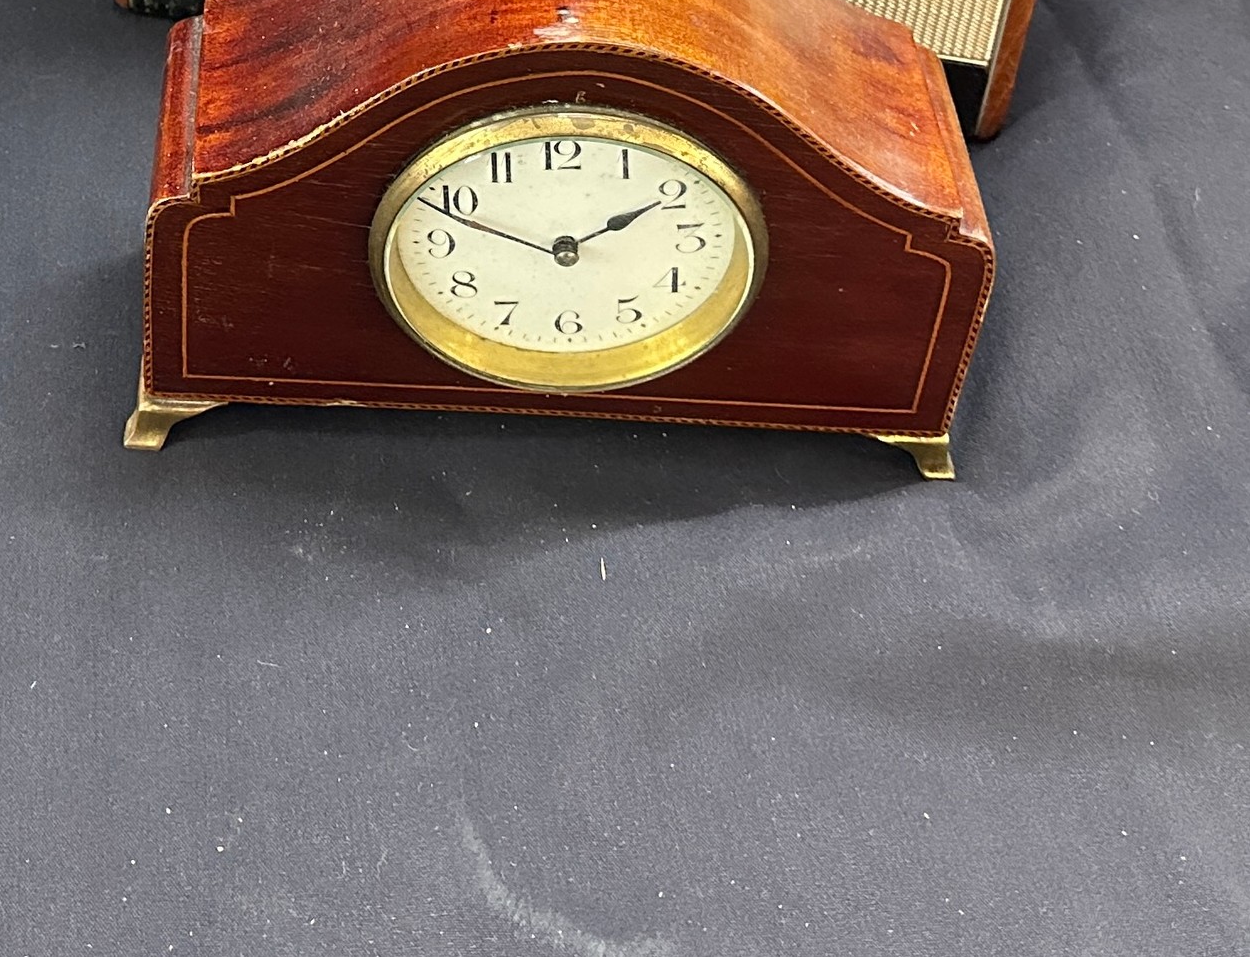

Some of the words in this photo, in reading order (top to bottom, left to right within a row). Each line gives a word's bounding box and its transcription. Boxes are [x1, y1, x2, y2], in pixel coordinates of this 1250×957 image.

[488, 152, 513, 183] 11
[540, 141, 582, 171] 12
[617, 149, 630, 179] 1
[439, 184, 479, 216] 10
[658, 179, 687, 210] 2
[427, 228, 456, 259] 9
[675, 223, 706, 254] 3
[450, 270, 478, 298] 8
[652, 267, 687, 293] 4
[494, 300, 519, 326] 7
[554, 309, 583, 335] 6
[616, 295, 642, 324] 5
